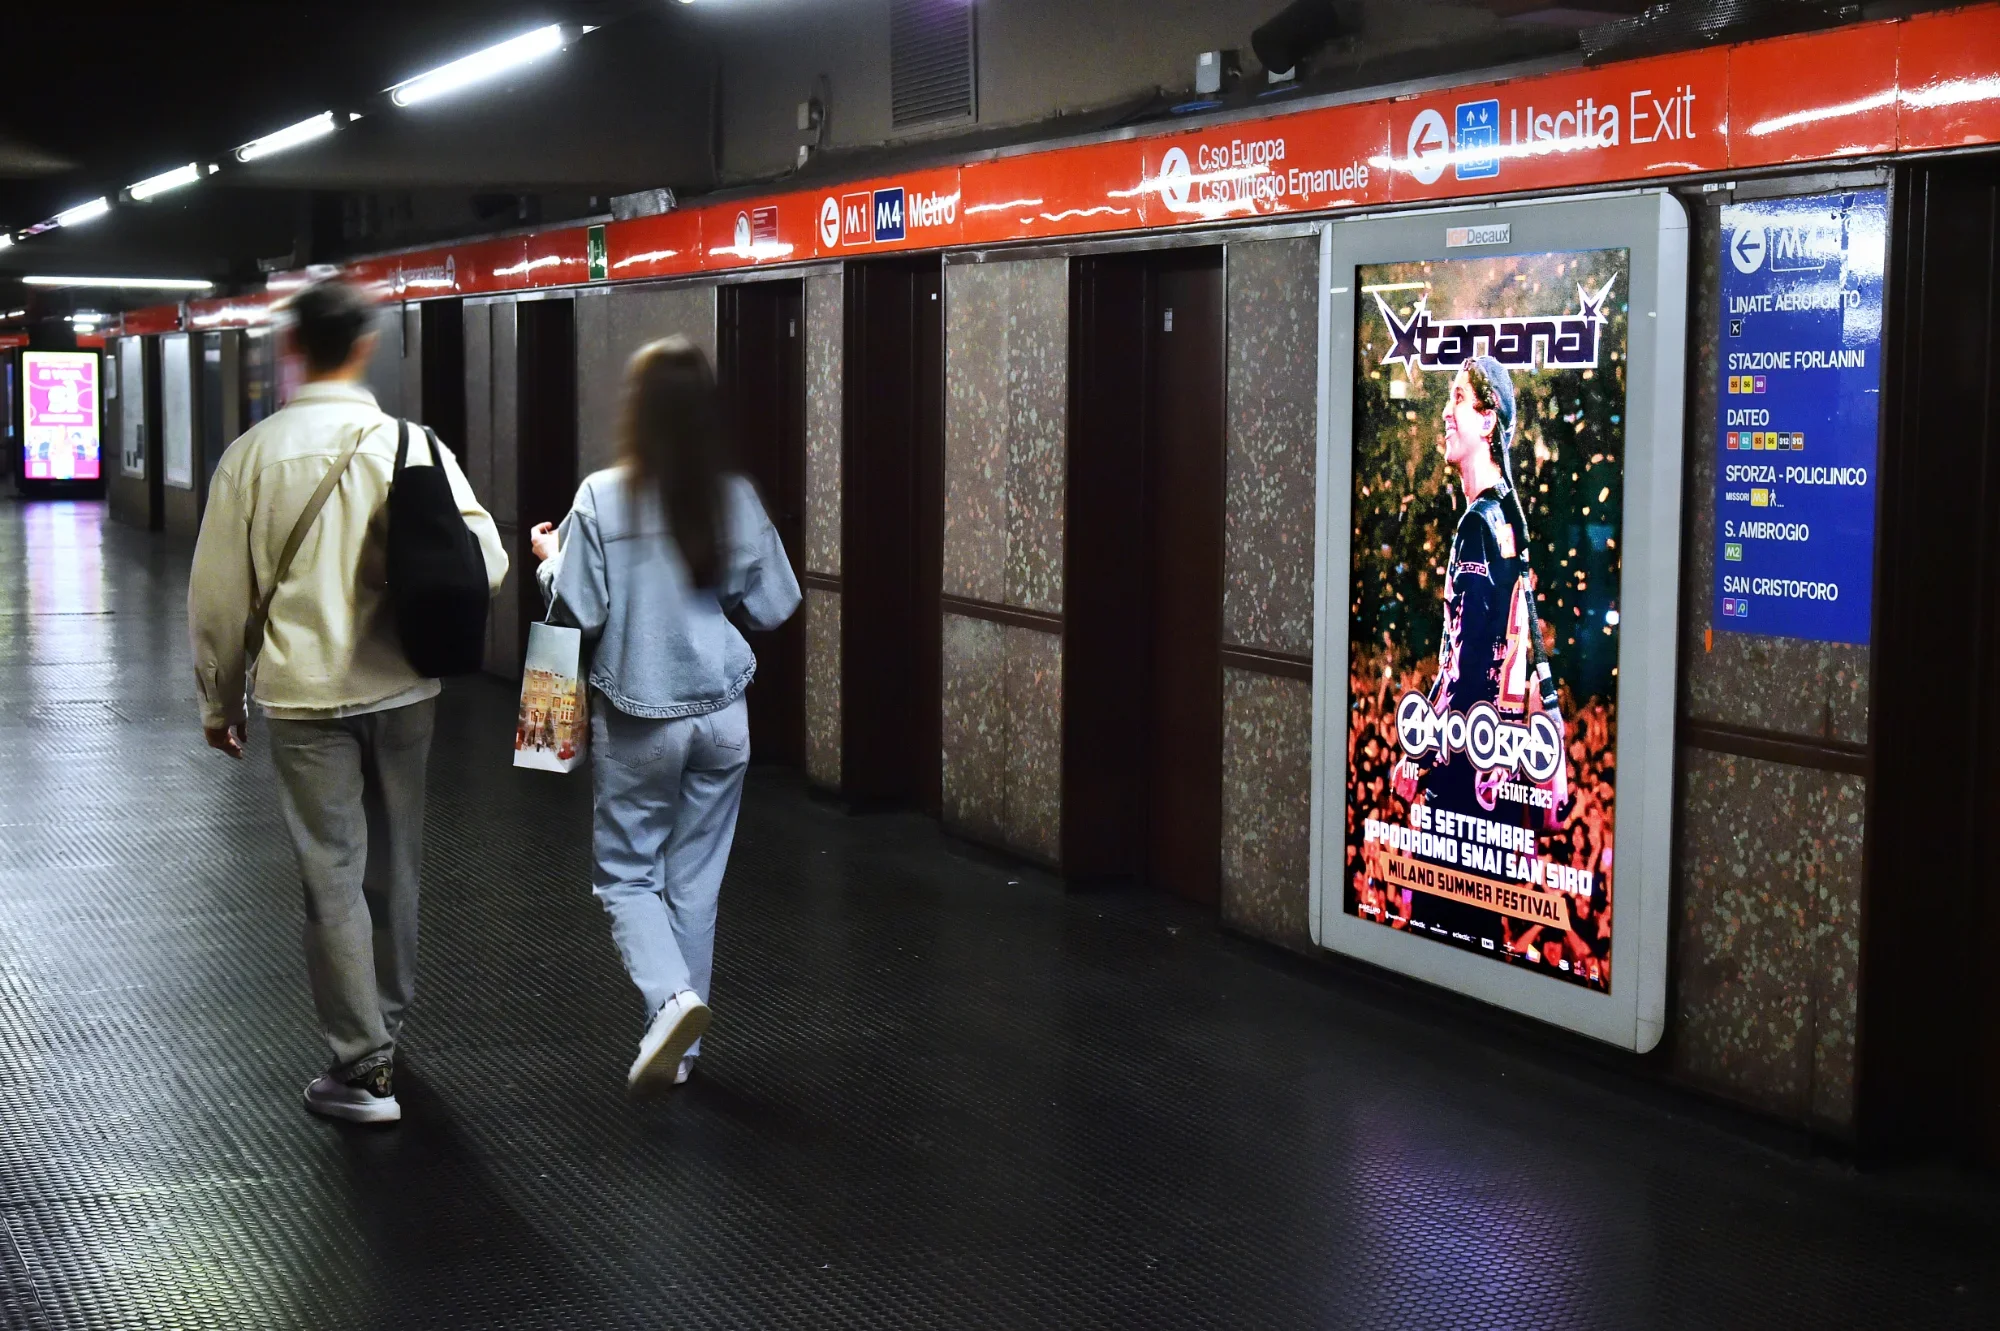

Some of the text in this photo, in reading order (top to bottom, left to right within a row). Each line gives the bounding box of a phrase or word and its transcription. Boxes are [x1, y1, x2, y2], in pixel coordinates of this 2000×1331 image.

[1511, 85, 1696, 152] Uscita Exit
[1199, 138, 1285, 170] C.so Europa
[1288, 161, 1369, 195] Emanuele
[845, 191, 956, 235] M1 M4 Metro
[1729, 290, 1861, 314] LINATE AEROPORTO
[1728, 350, 1865, 370] STAZIONE FORLANINI
[1727, 409, 1770, 426] DATEO
[1725, 465, 1777, 483] SFORZA
[1785, 466, 1867, 486] POLICLINICO
[1725, 492, 1750, 501] MISSORI
[1725, 520, 1809, 541] S. AMBROGIO
[1726, 547, 1741, 558] M2
[1723, 575, 1838, 601] SAN CRISTOFORO
[1402, 761, 1419, 781] LIVE
[1499, 781, 1553, 809] ESTATE 2025
[1410, 803, 1535, 854] 05 SETTEMBRE
[1364, 818, 1593, 896] IPPODROMO SNAI SAN SIRO
[1388, 859, 1561, 921] MILANO SUMMER FESTIVAL
